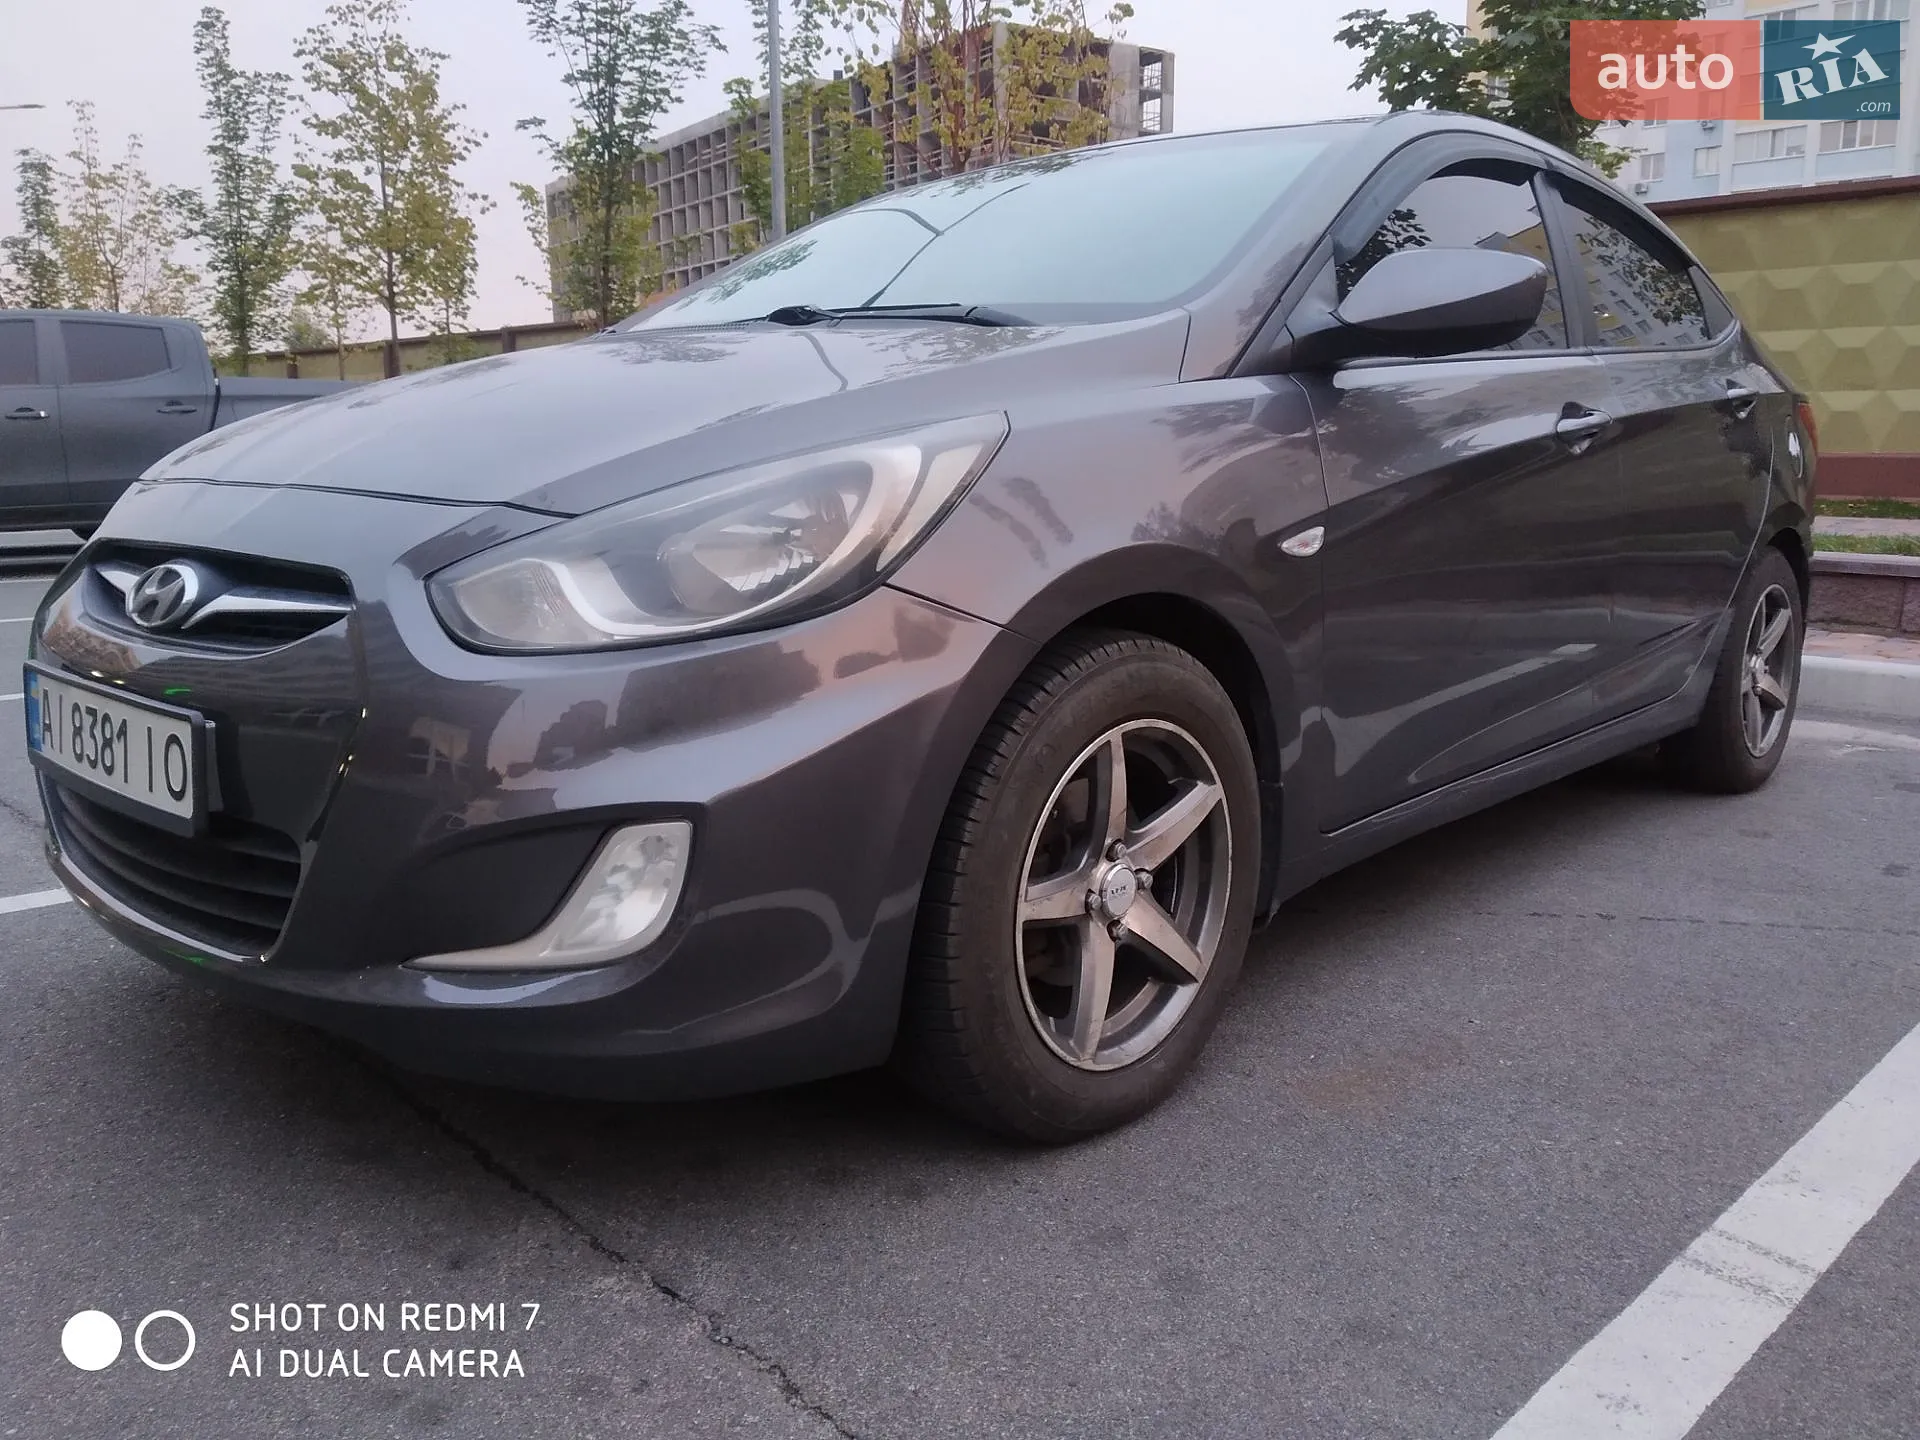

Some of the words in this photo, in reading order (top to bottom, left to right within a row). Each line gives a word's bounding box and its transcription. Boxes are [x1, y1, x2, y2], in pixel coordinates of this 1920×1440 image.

[42, 687, 63, 754] AI
[71, 702, 129, 784] 8381
[146, 725, 188, 802] IO
